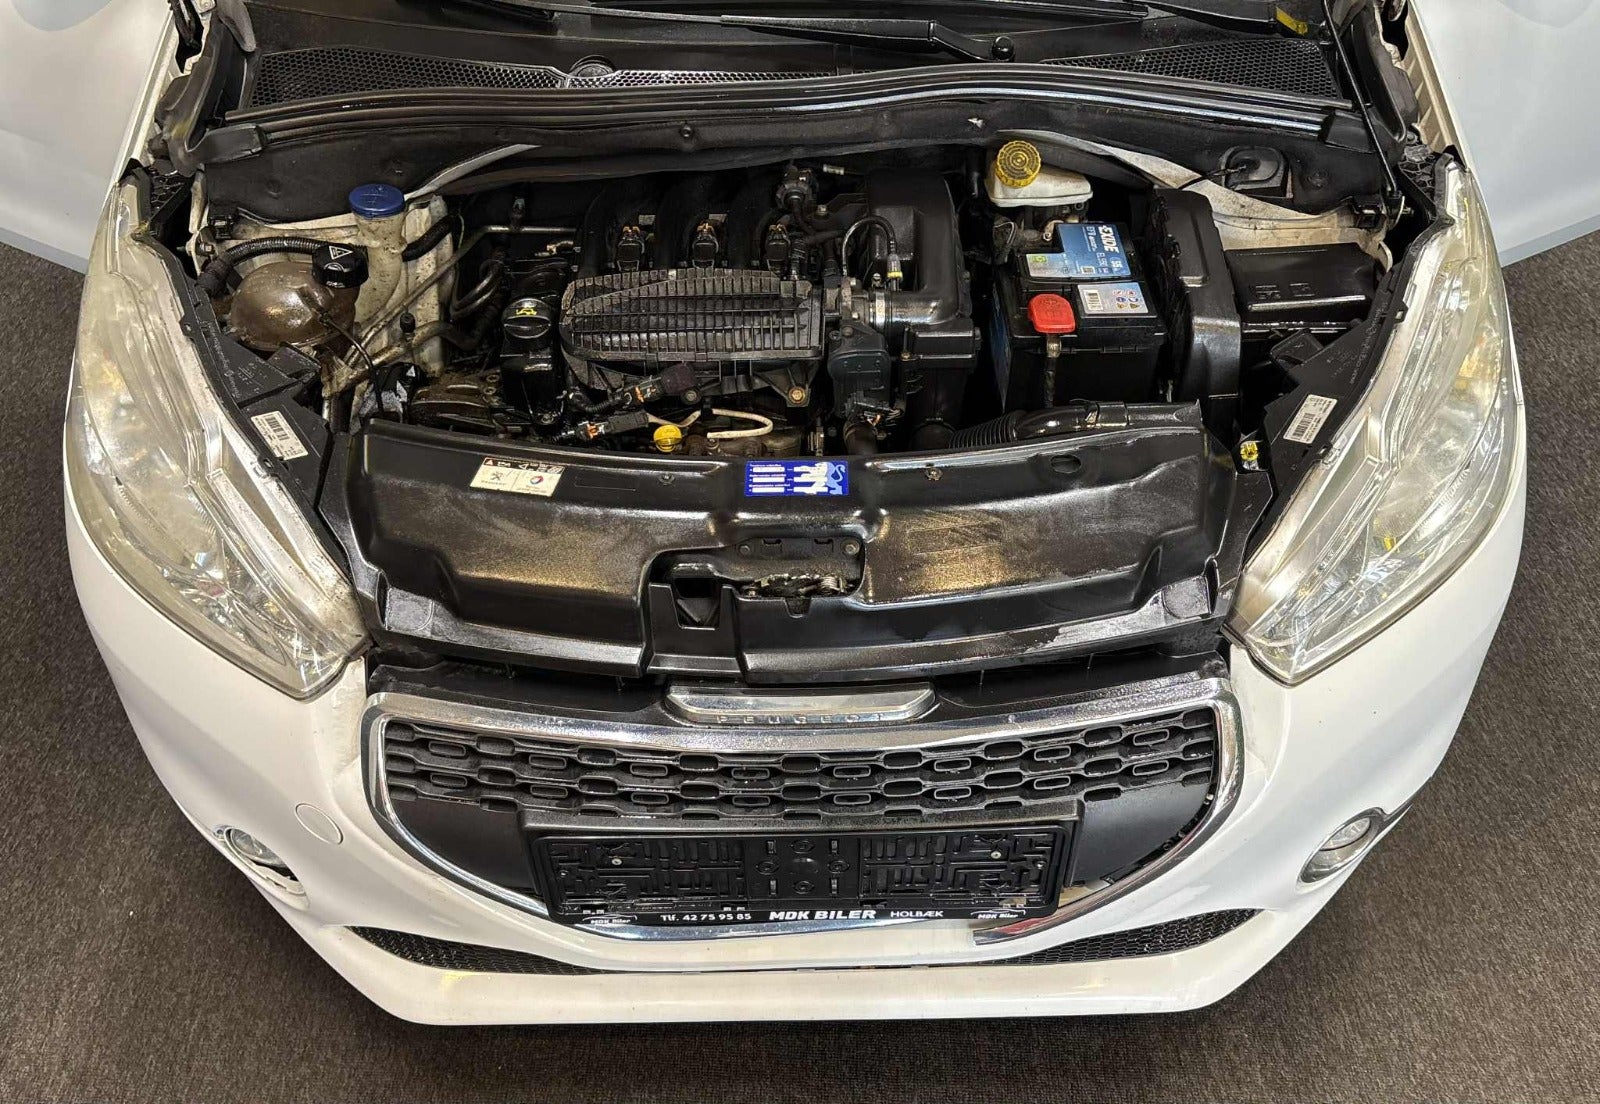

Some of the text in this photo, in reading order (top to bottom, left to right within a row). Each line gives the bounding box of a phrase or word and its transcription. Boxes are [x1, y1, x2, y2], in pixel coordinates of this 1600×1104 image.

[1098, 225, 1119, 253] EXIDE
[660, 914, 680, 922] Tlf.
[700, 913, 716, 921] 75
[769, 910, 877, 920] MDK BILER
